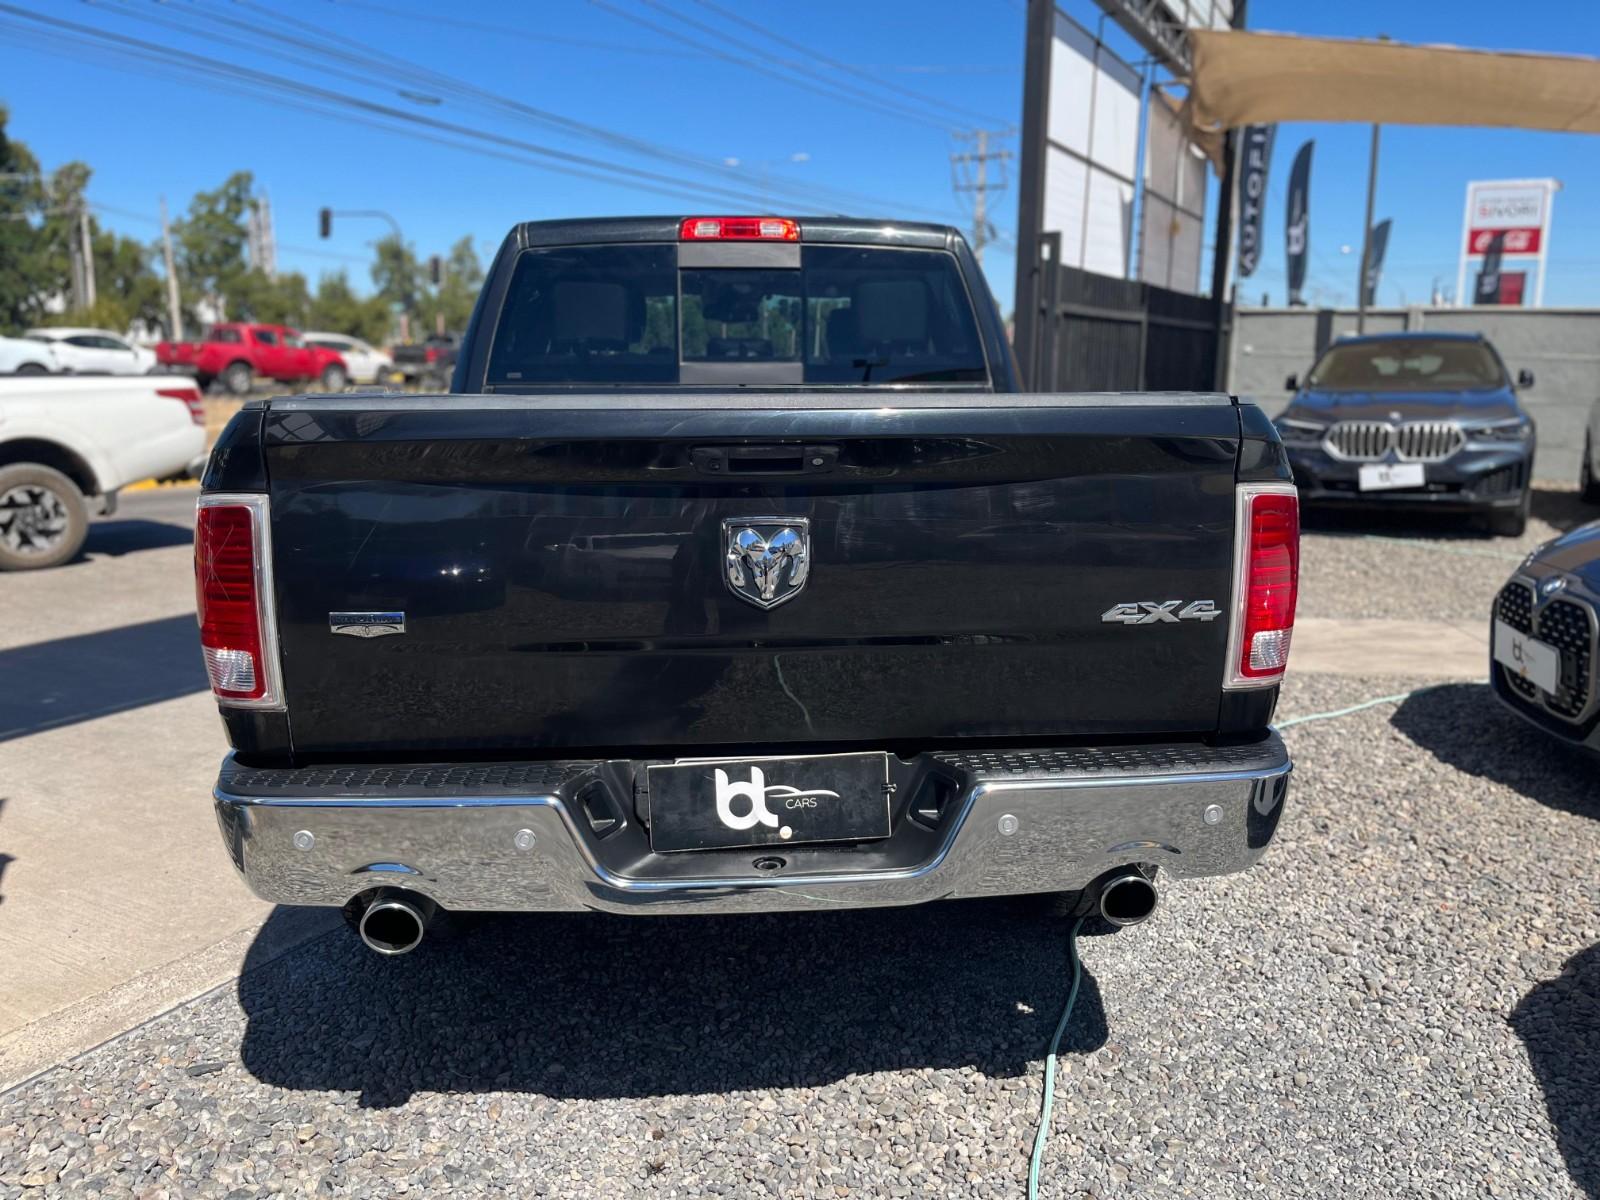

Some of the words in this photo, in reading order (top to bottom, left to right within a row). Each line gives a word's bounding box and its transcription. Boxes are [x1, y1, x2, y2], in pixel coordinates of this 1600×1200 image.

[1240, 122, 1266, 272] AUTOFI
[1102, 600, 1222, 625] 4X4
[785, 797, 818, 810] CARS
